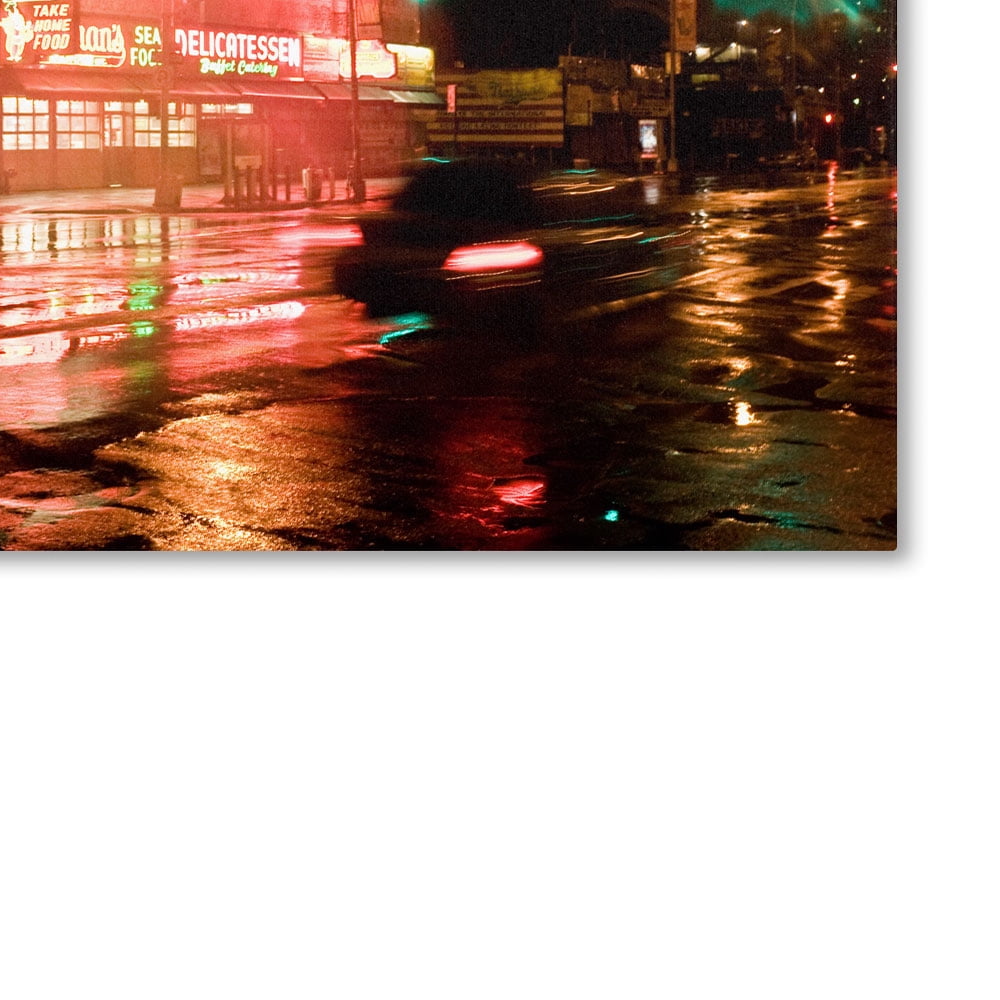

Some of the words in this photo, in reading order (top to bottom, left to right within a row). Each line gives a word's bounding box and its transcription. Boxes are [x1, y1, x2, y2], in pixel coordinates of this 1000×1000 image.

[33, 4, 69, 17] TAKE
[33, 19, 71, 32] HOME
[33, 33, 70, 50] FOOD
[134, 25, 162, 45] SEA
[174, 29, 300, 67] DELICATESSEN
[200, 58, 235, 75] Buffet
[238, 59, 278, 77] Catering
